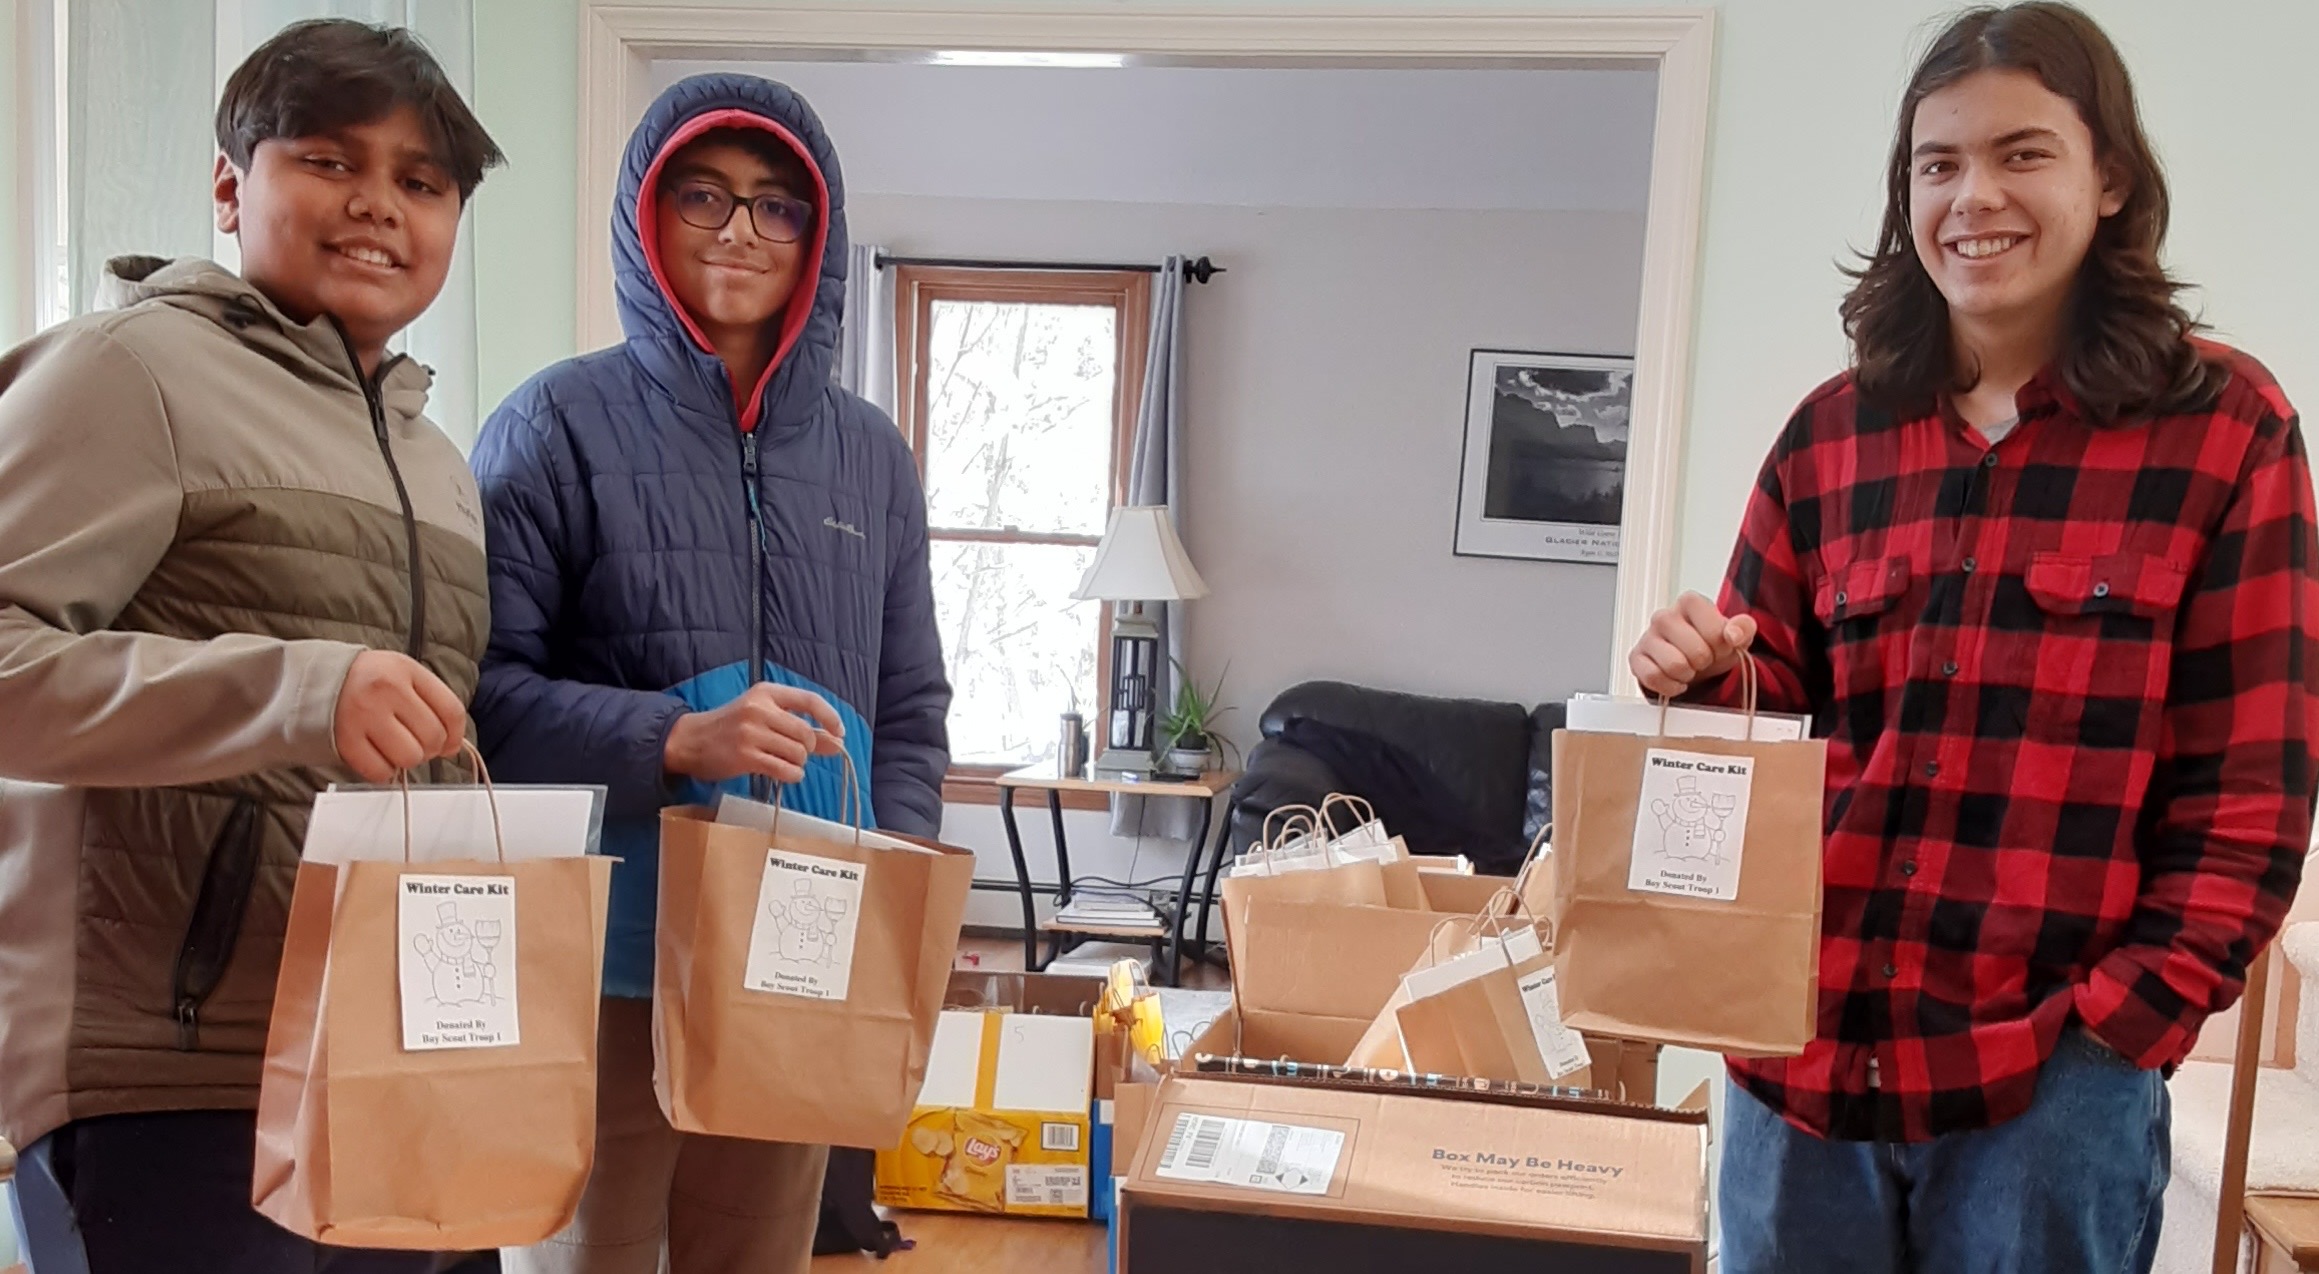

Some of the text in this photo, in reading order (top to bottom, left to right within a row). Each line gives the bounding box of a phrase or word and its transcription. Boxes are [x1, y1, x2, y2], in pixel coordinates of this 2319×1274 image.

[1651, 757, 1747, 776] Winter Care Kit
[770, 857, 859, 881] Winter Care Kit
[1660, 870, 1707, 884] Donated By
[406, 882, 509, 895] Winter Care Kit
[1645, 879, 1660, 888] Boy
[1662, 881, 1685, 890] Scout
[1688, 883, 1713, 895] Troop
[775, 971, 818, 986] Donated By
[761, 980, 775, 990] Boy
[777, 983, 798, 992] Scout
[801, 986, 824, 998] Troop
[436, 1019, 486, 1031] Donated By
[422, 1034, 439, 1044] Boy
[441, 1033, 467, 1043] Scout
[468, 1032, 494, 1043] Troop
[965, 1137, 1001, 1161] Lay's
[1432, 1148, 1624, 1178] Box May Be Heavy
